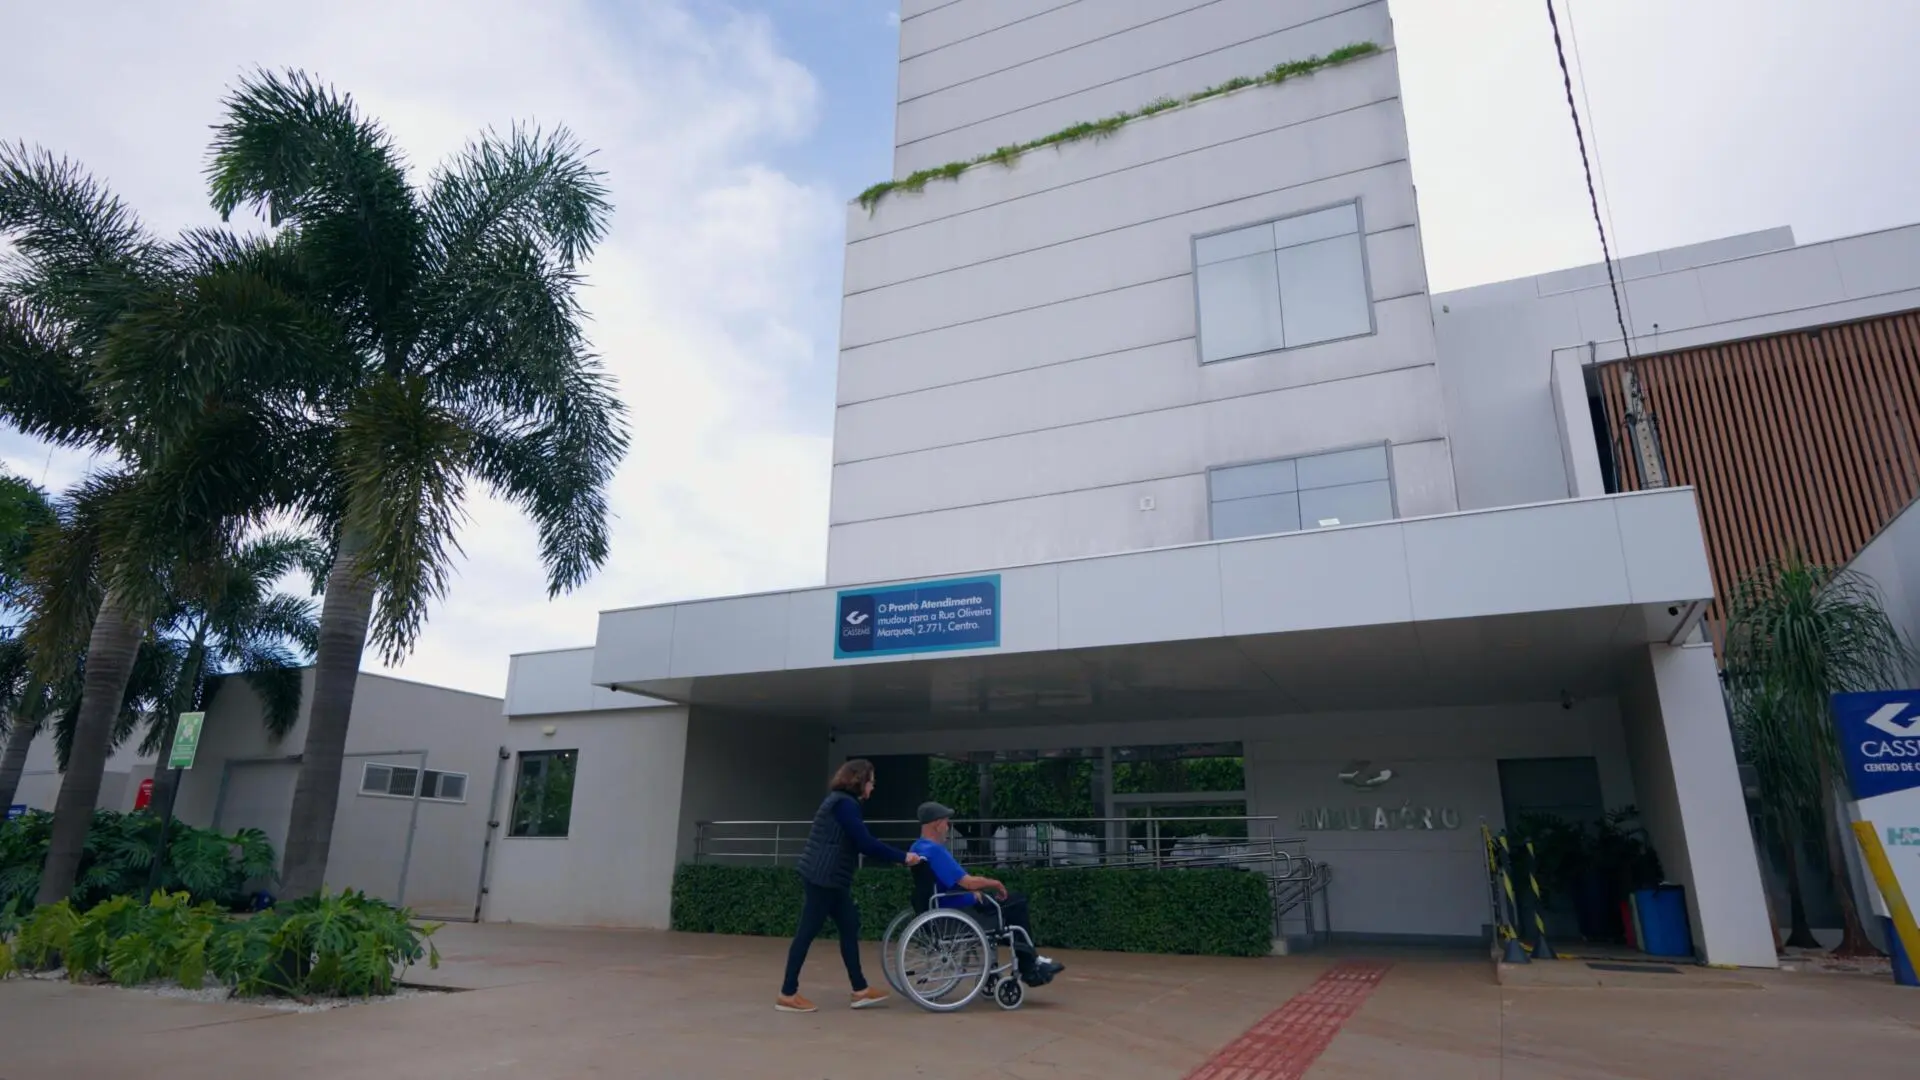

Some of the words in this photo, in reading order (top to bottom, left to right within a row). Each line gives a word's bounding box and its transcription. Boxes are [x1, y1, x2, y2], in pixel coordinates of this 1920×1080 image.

[878, 604, 888, 613] O
[889, 602, 919, 613] Pronto
[921, 596, 982, 610] Atendimento
[878, 614, 907, 625] mudou
[909, 614, 929, 624] para
[939, 611, 955, 620] Rua
[957, 606, 992, 618] Oliveira
[877, 626, 915, 638] Marques,
[918, 623, 945, 634] 2.771,
[948, 620, 980, 631] Centro.
[1861, 740, 1920, 757] CASS
[1864, 762, 1900, 772] CENTRO
[1901, 762, 1914, 772] DE
